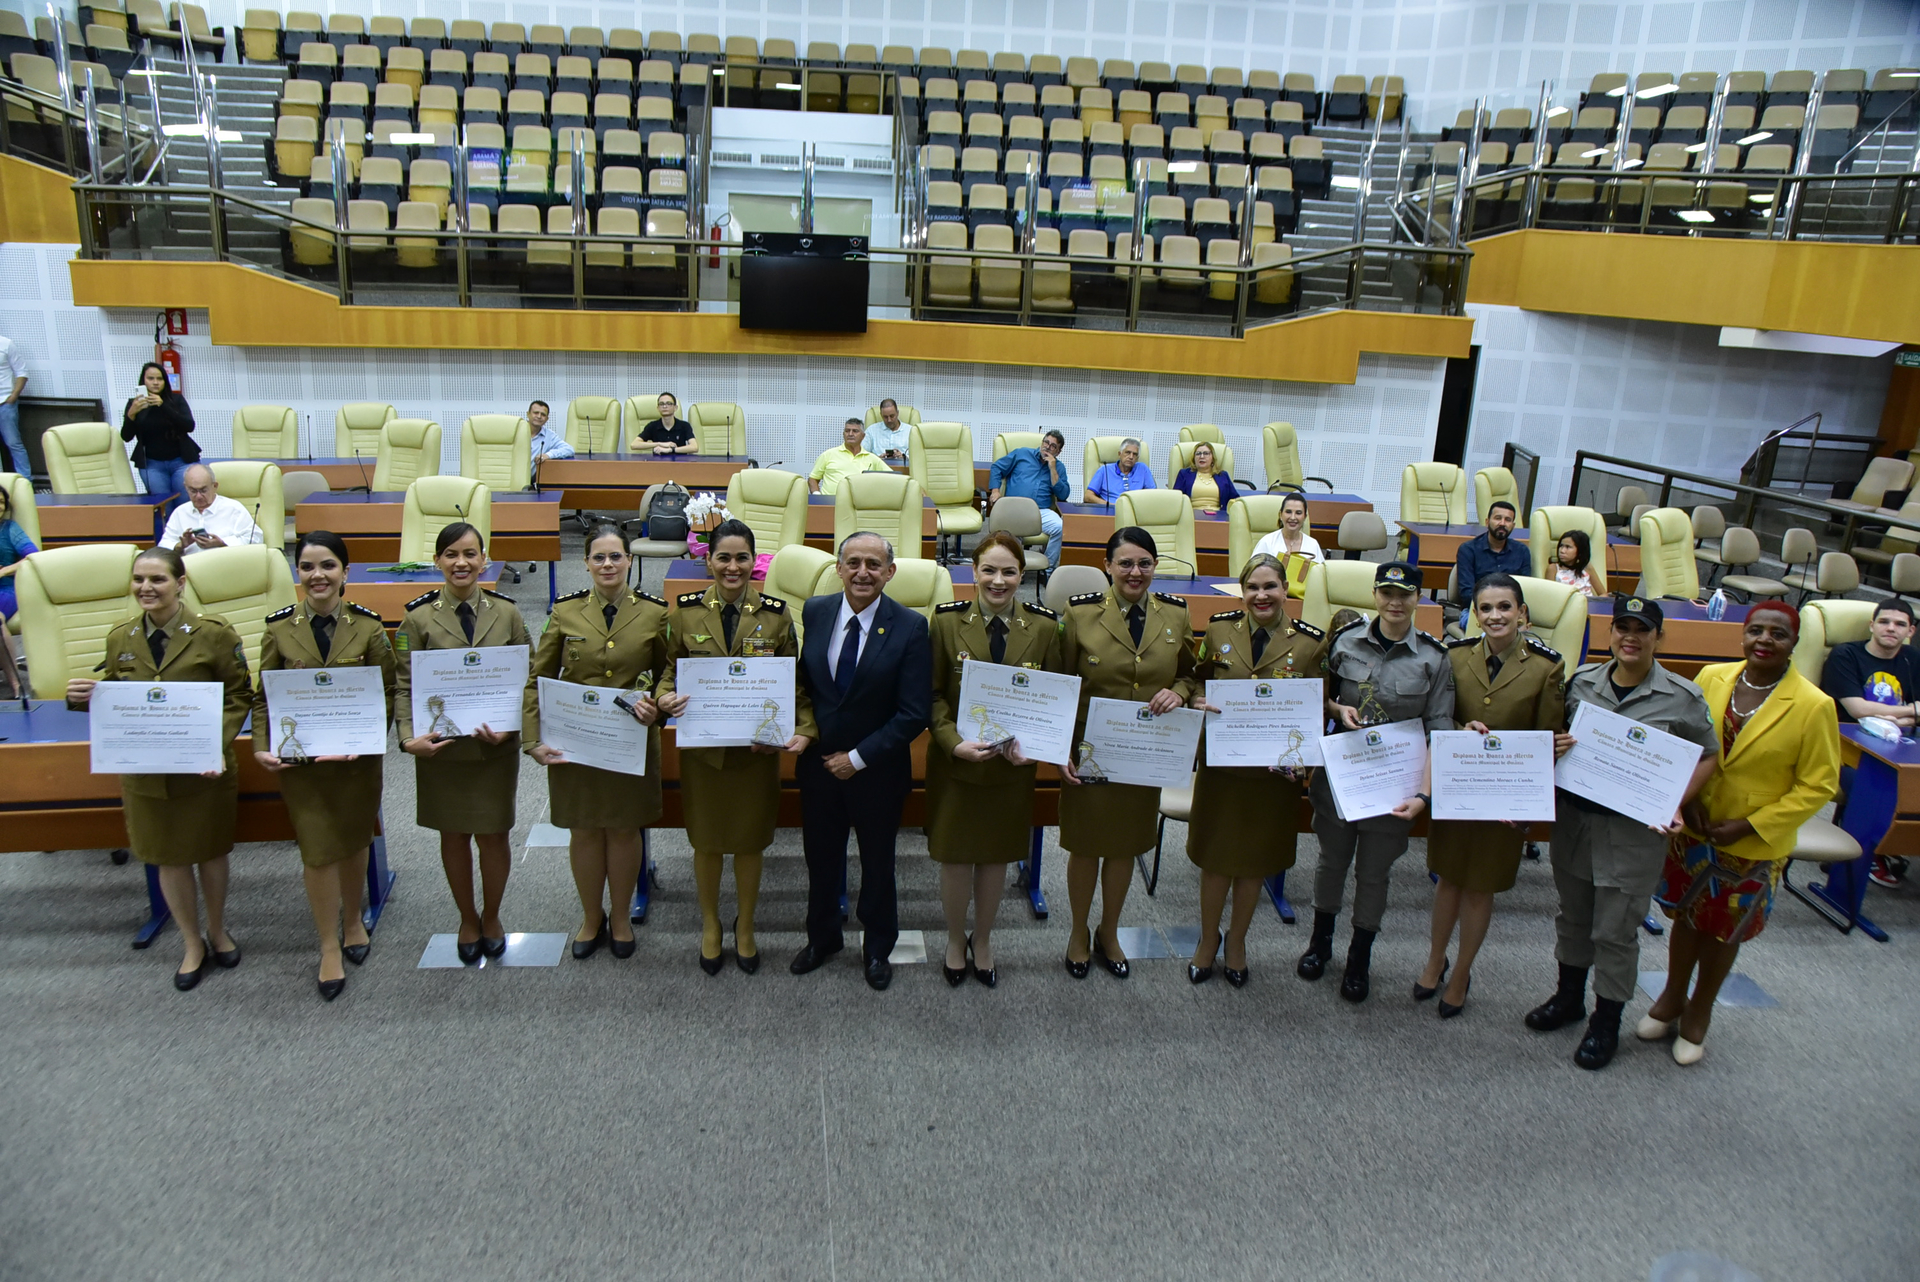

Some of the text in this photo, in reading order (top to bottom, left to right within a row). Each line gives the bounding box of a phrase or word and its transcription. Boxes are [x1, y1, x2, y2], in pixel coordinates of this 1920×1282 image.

[1904, 353, 1920, 361] SAÍD
[980, 682, 1004, 691] Diploma
[1012, 687, 1030, 695] Honra
[1039, 692, 1058, 700] Mérito
